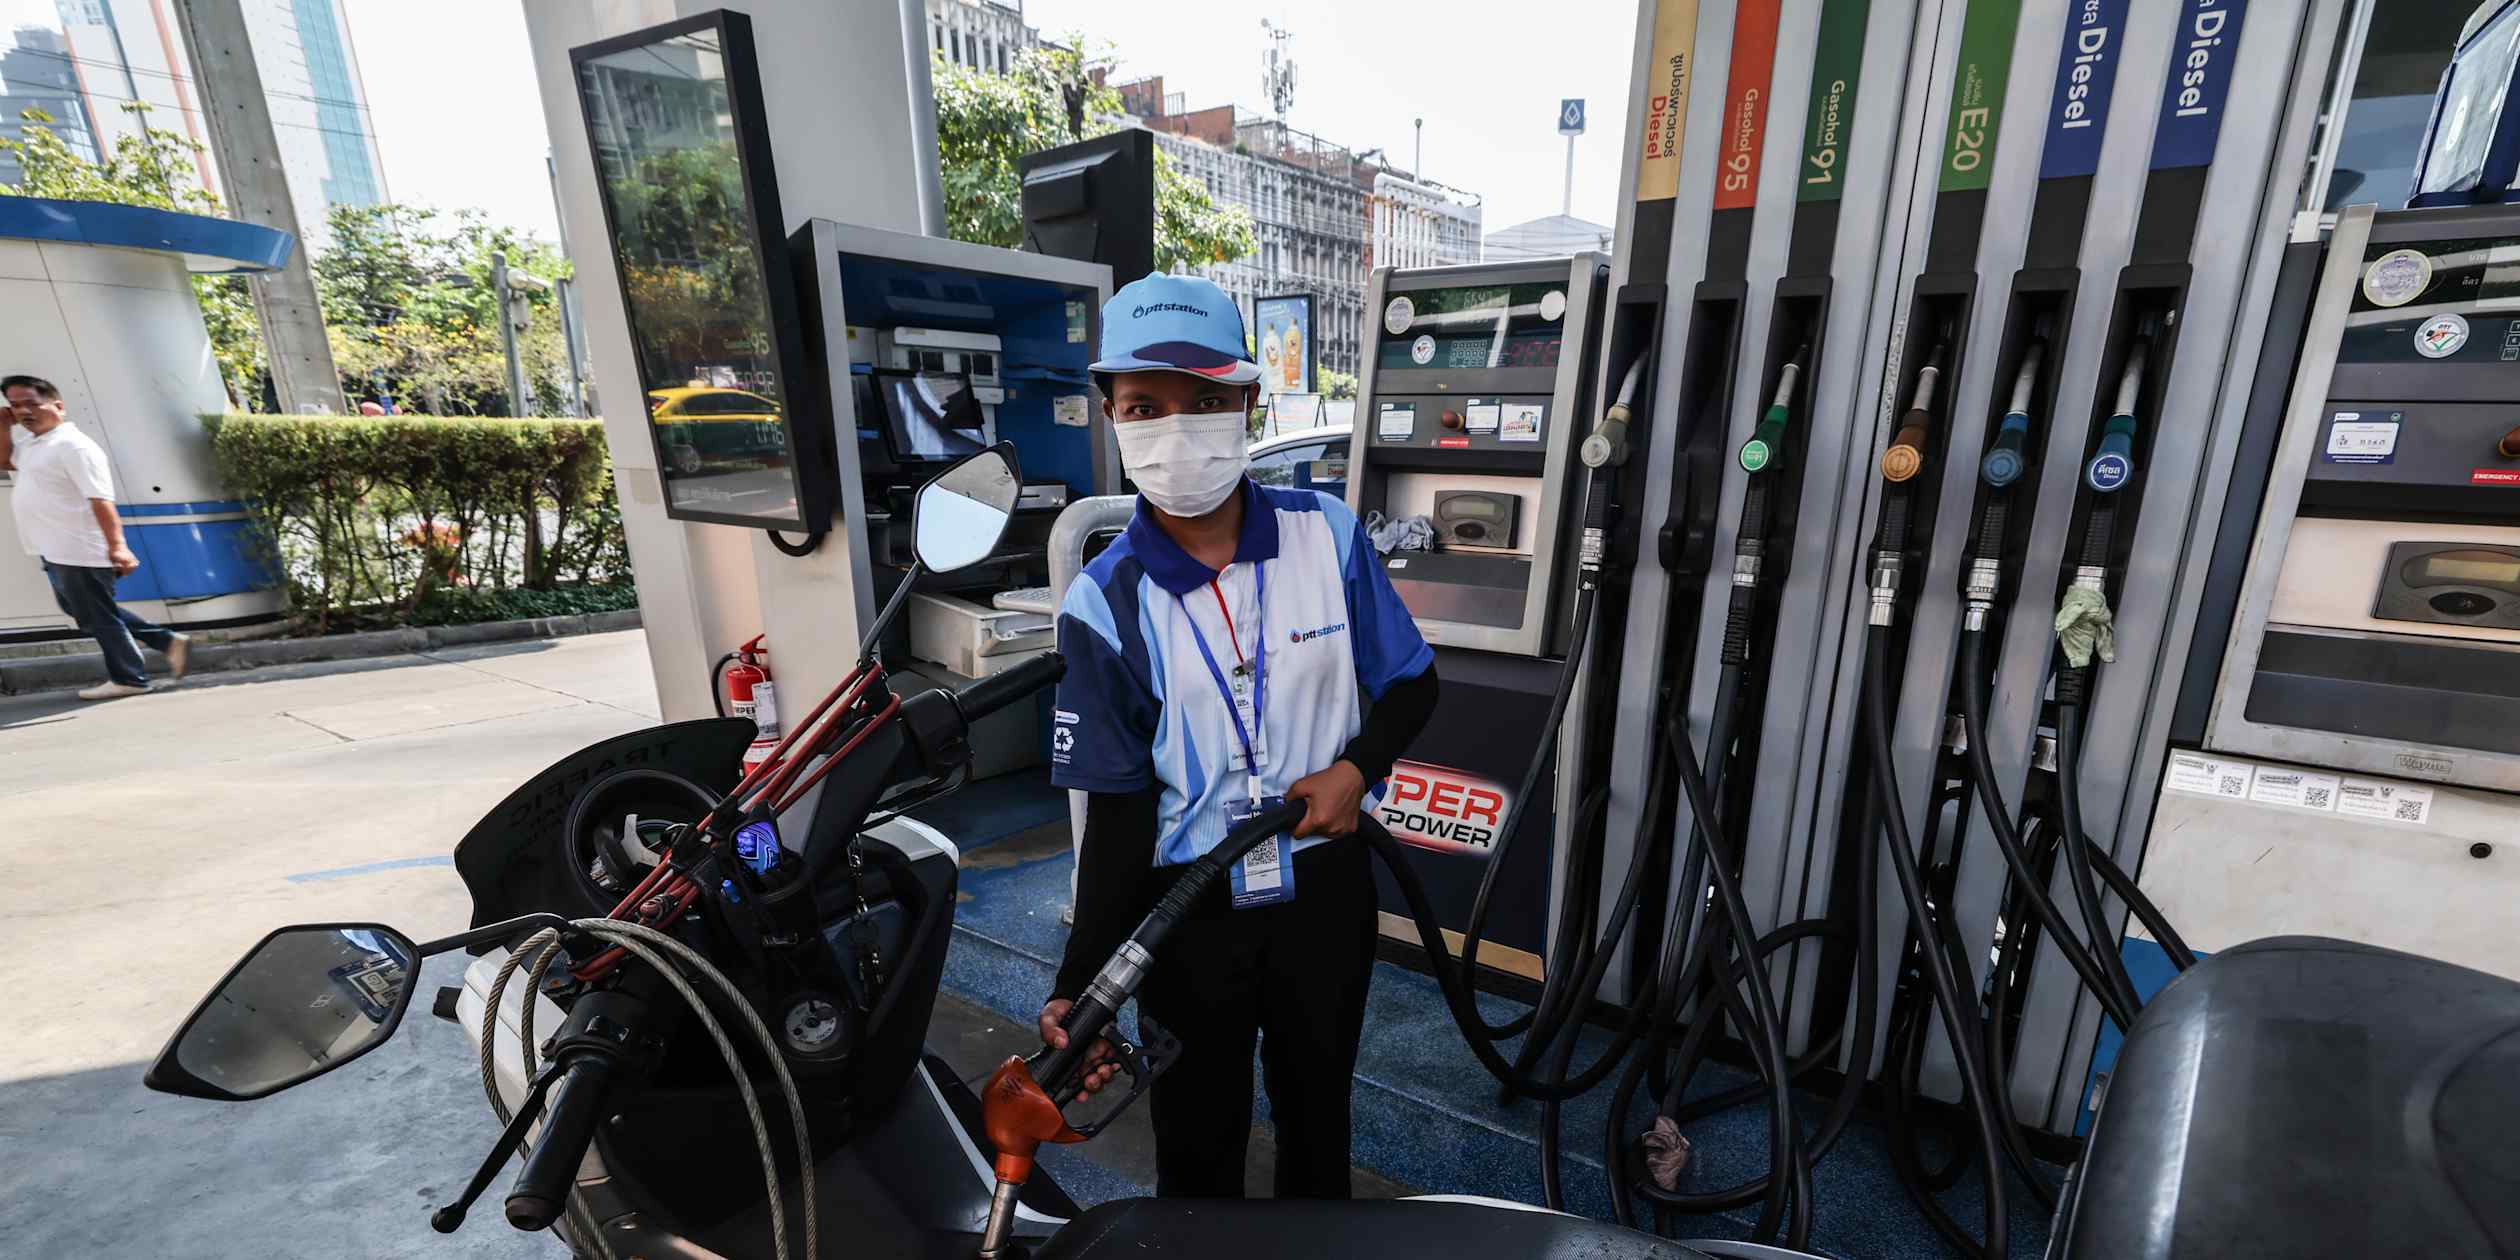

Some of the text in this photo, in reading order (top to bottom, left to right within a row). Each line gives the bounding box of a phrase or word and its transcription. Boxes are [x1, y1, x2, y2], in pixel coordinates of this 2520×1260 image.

[2062, 27, 2108, 129] Diesel
[2176, 9, 2227, 117] Diesel
[1647, 96, 1667, 160] Diesel
[1737, 88, 1758, 151] Gasohol
[1823, 80, 1846, 147] Gasohol
[1952, 107, 1989, 172] E20
[1724, 153, 1751, 191] 95
[1807, 148, 1836, 185] 91
[2473, 473, 2518, 481] EMERGENCY
[1381, 807, 1493, 848] POWER
